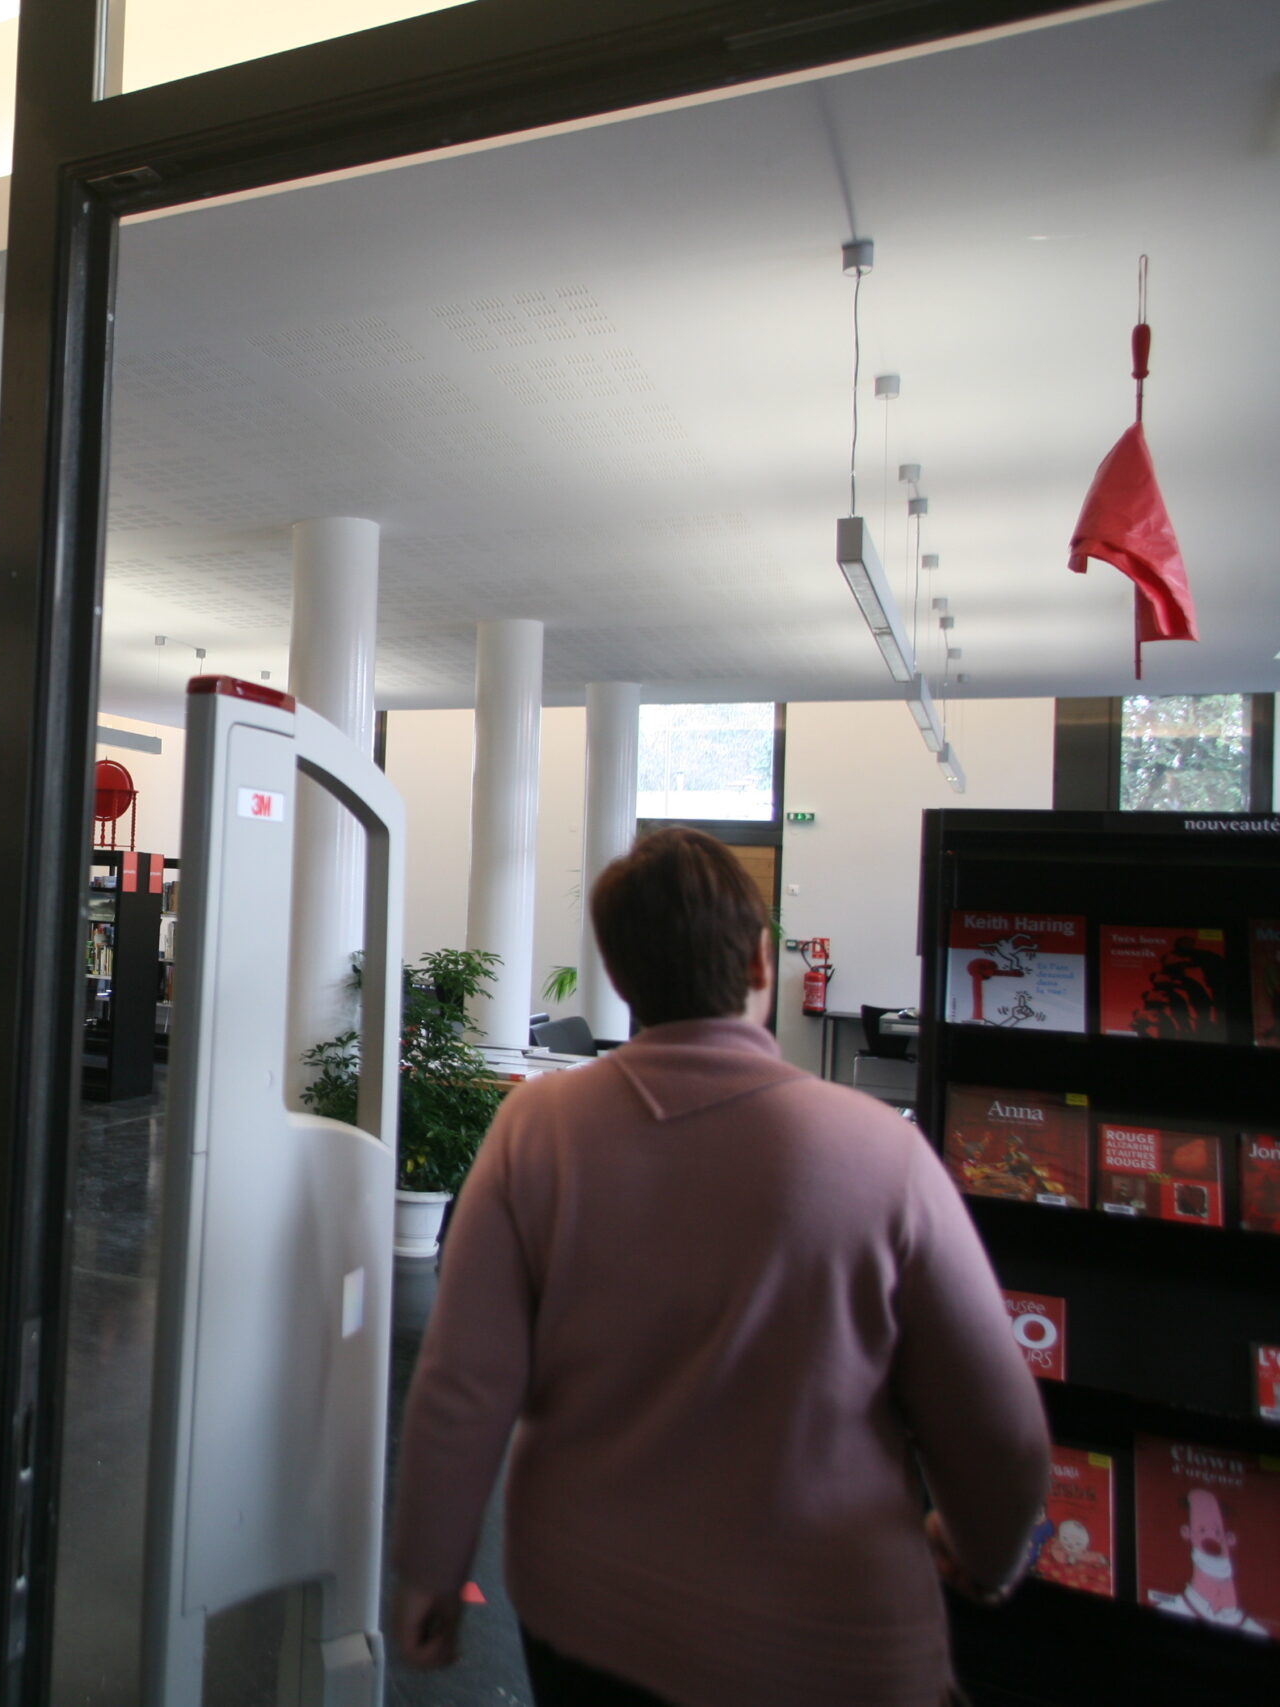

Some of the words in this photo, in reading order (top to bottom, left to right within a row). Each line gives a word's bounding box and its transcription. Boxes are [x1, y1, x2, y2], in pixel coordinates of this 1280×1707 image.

[251, 792, 273, 817] 3M
[963, 914, 1009, 930] Keith
[1014, 916, 1075, 936] Haring
[987, 1100, 1045, 1121] Anna
[1105, 1130, 1156, 1144] ROUGE
[1105, 1156, 1157, 1169] ROUGES
[1117, 1150, 1156, 1161] AUTRES
[1169, 1443, 1245, 1474] Clown
[1171, 1462, 1245, 1488] d'urgence
